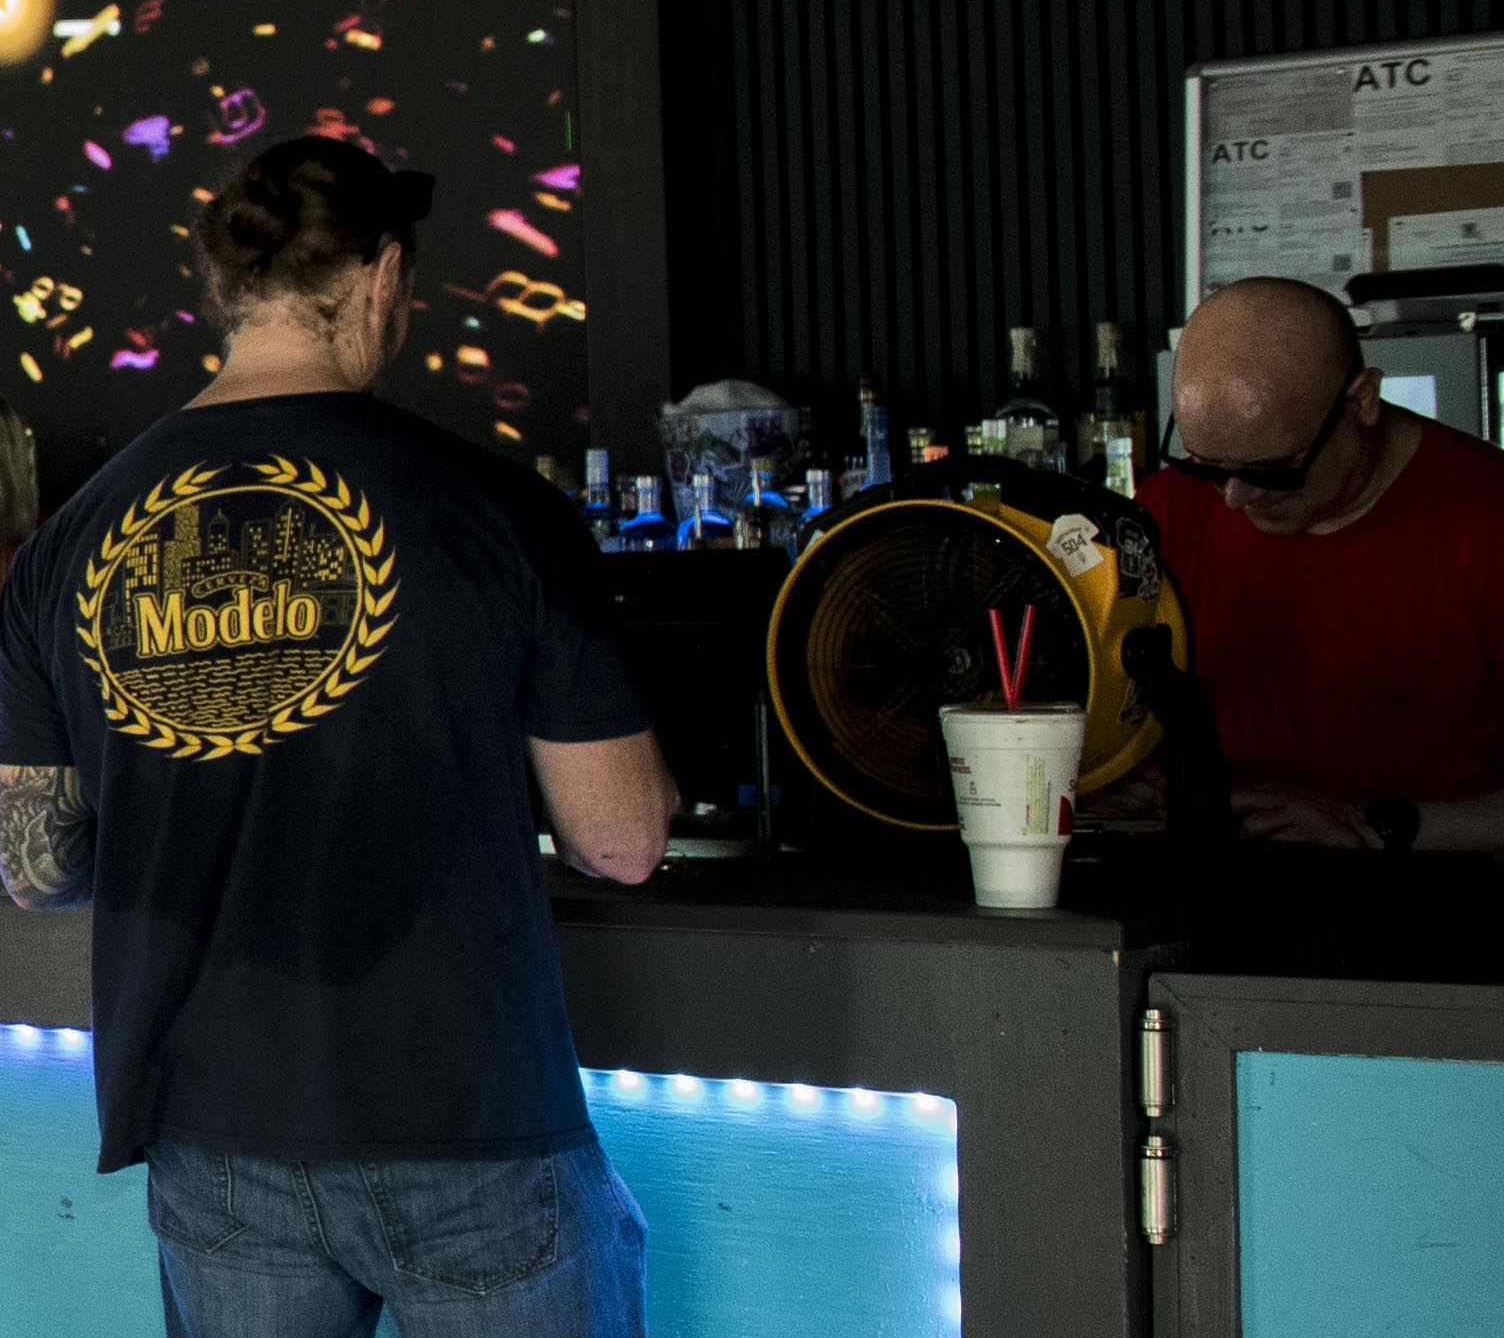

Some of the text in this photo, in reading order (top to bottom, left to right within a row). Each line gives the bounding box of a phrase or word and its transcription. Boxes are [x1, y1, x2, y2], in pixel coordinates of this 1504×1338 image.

[1353, 59, 1431, 92] ATC
[1212, 139, 1269, 163] ATC
[1061, 533, 1088, 556] 504
[194, 573, 267, 596] CERVEZA
[137, 581, 318, 657] Modelo
